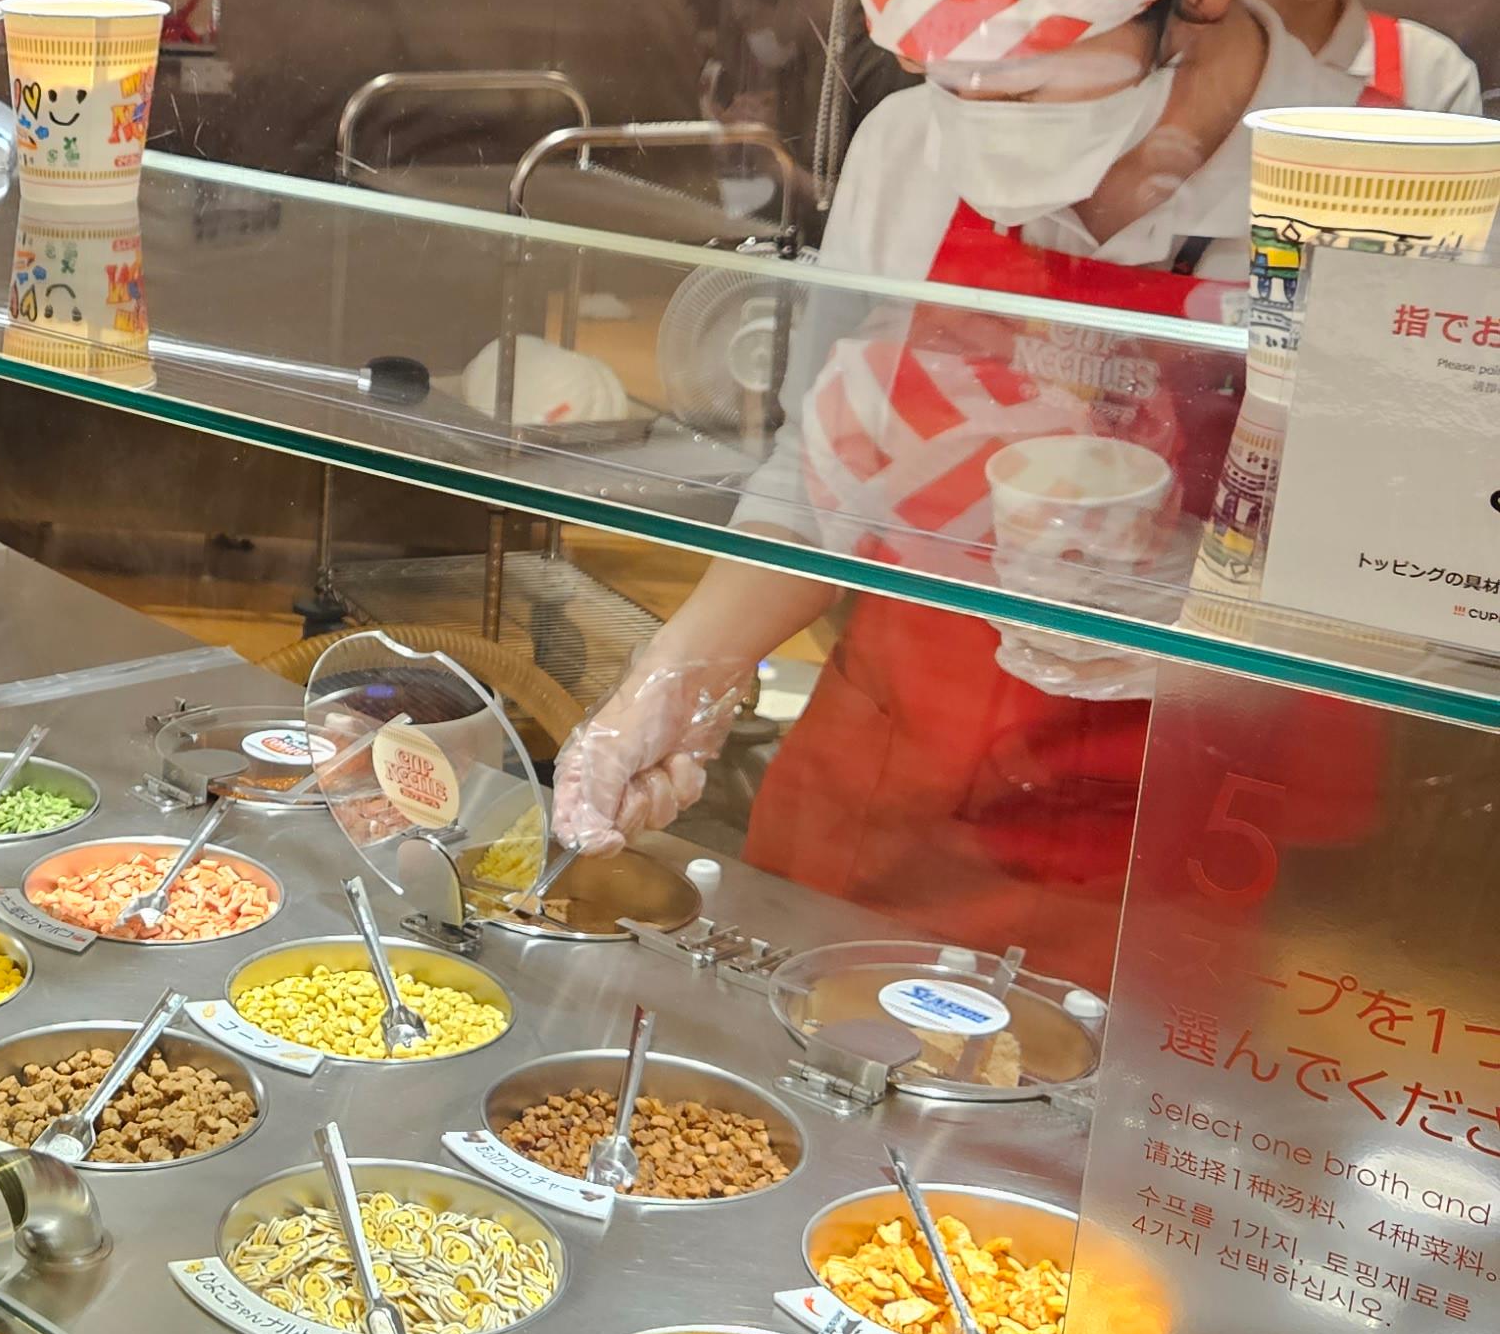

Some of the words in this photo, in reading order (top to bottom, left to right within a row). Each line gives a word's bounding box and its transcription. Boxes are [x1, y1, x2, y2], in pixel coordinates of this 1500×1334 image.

[1392, 304, 1500, 348] 指でお
[1437, 358, 1476, 373] Please
[1359, 552, 1500, 595] トッピングの具材
[1468, 608, 1500, 623] CUP
[1188, 771, 1286, 907] 5
[217, 1020, 278, 1048] コーン
[1149, 1092, 1243, 1142] Select
[1252, 1133, 1312, 1165] one
[1324, 1151, 1409, 1200] broth
[1422, 1190, 1491, 1227] and
[1132, 1215, 1201, 1255] 4가지
[1217, 1244, 1391, 1327] 선택하십시오.
[1137, 1185, 1215, 1229] 수프를
[1232, 1218, 1304, 1266] 1가지,
[1321, 1251, 1471, 1322] 토핑재료를
